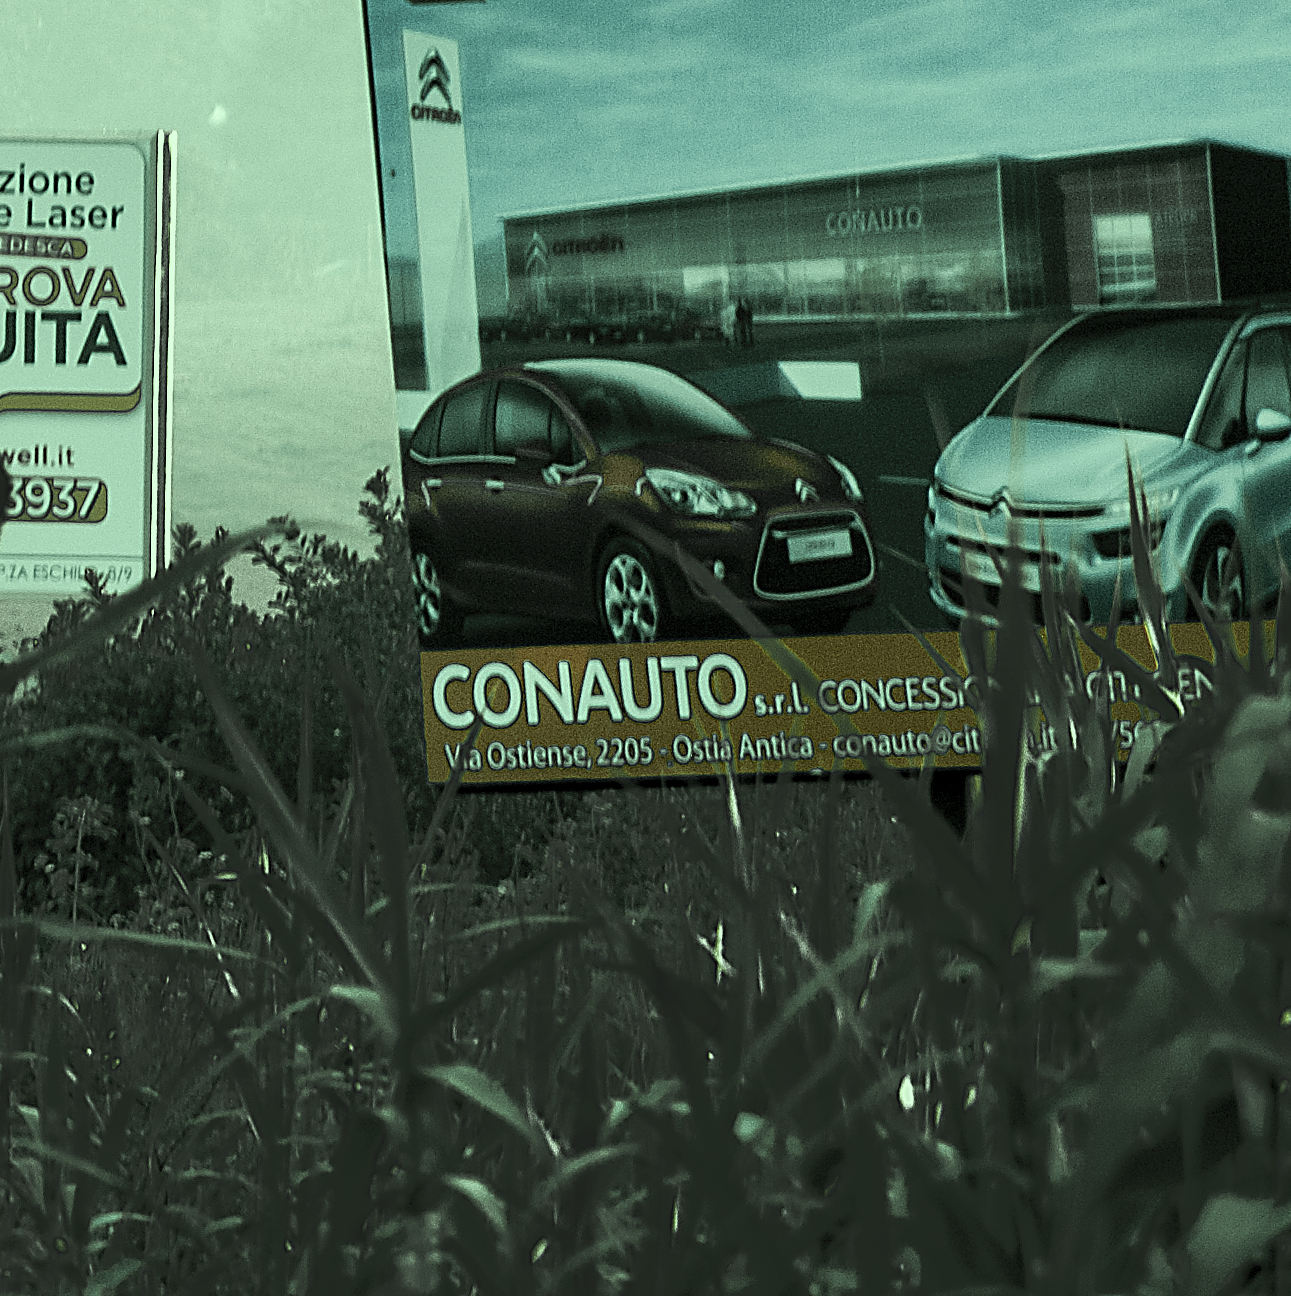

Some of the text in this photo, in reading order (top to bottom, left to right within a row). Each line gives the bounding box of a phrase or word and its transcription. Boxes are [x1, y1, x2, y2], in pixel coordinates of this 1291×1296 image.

[25, 196, 124, 230] Laser
[432, 652, 747, 730] CONAUTO
[754, 680, 810, 717] s.r.l.
[487, 738, 592, 770] Ostiense,
[596, 736, 653, 768] 2205
[672, 731, 732, 765] Ostia
[738, 731, 814, 762] Antica
